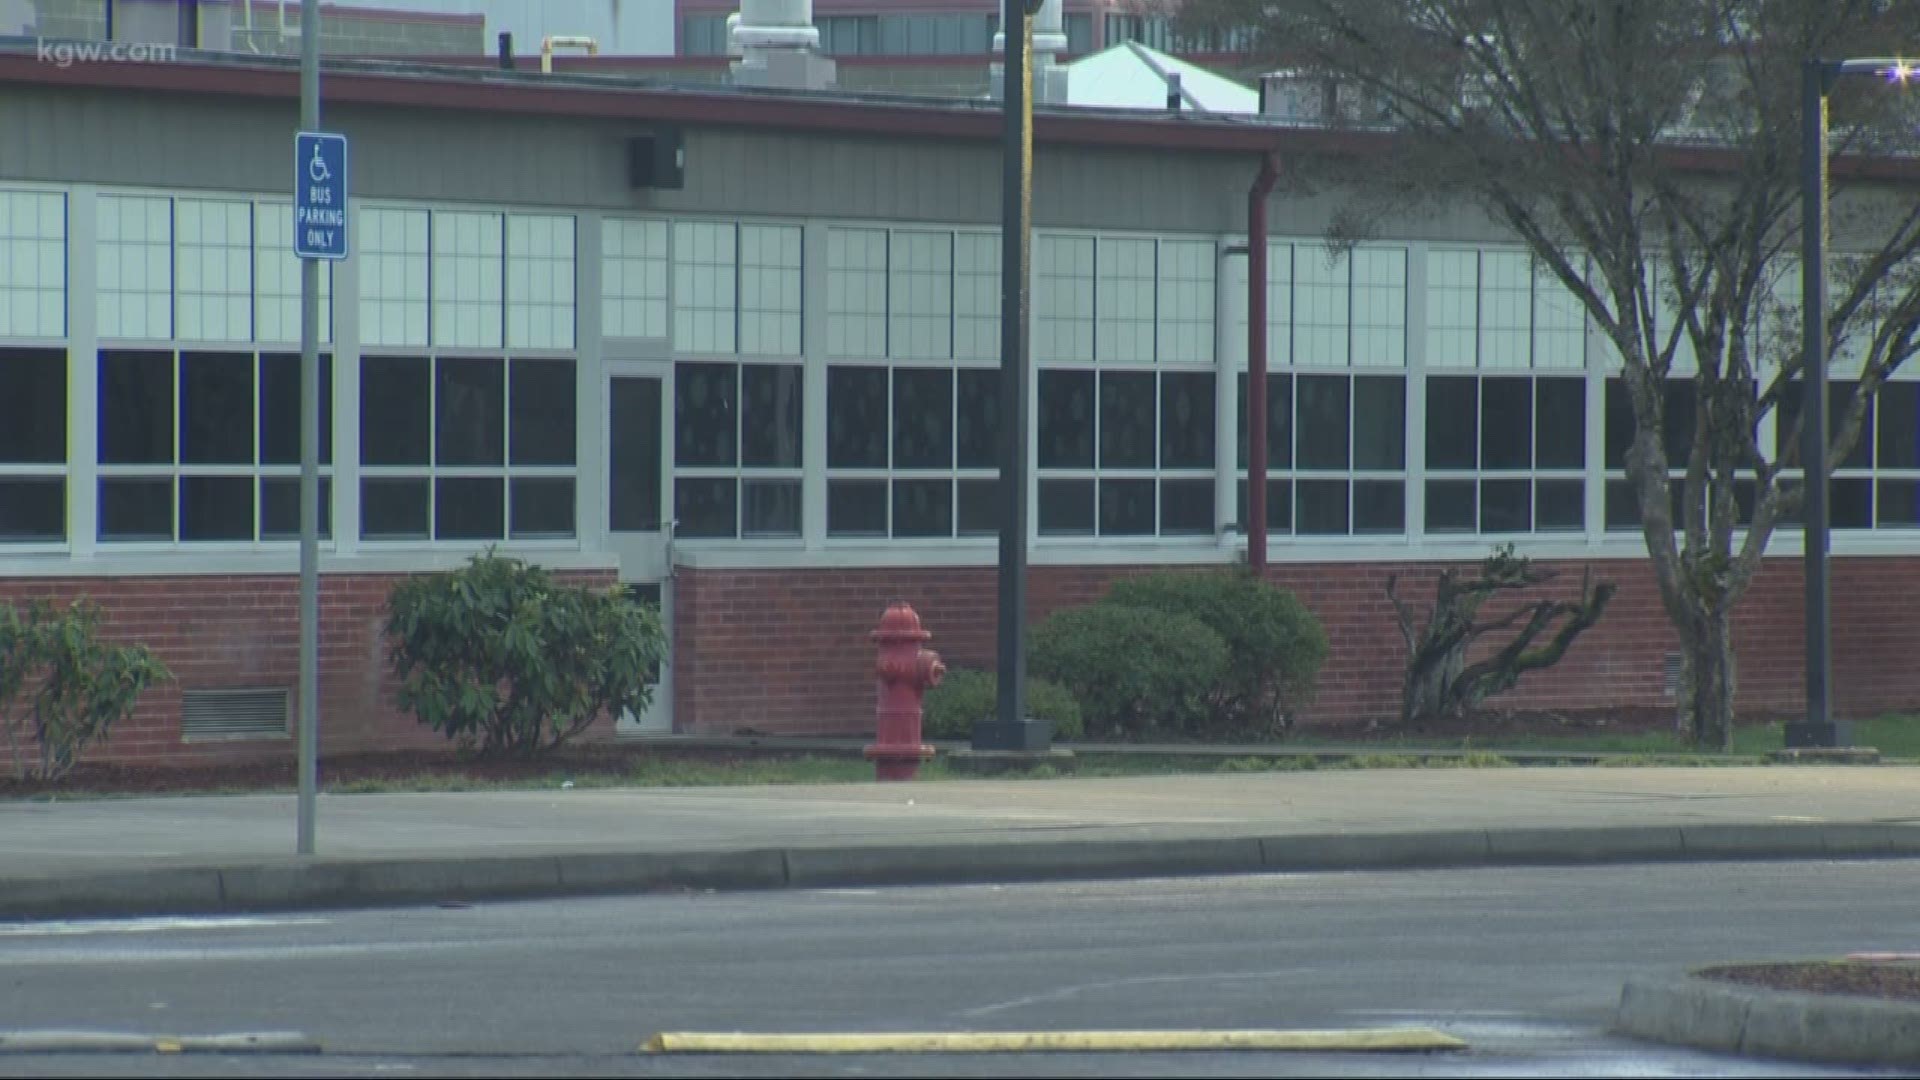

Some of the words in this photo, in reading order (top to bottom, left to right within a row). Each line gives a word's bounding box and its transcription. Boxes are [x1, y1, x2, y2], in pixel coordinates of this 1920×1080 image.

[310, 186, 331, 204] BUS
[299, 207, 343, 227] PARKING
[307, 229, 334, 247] ONLY
